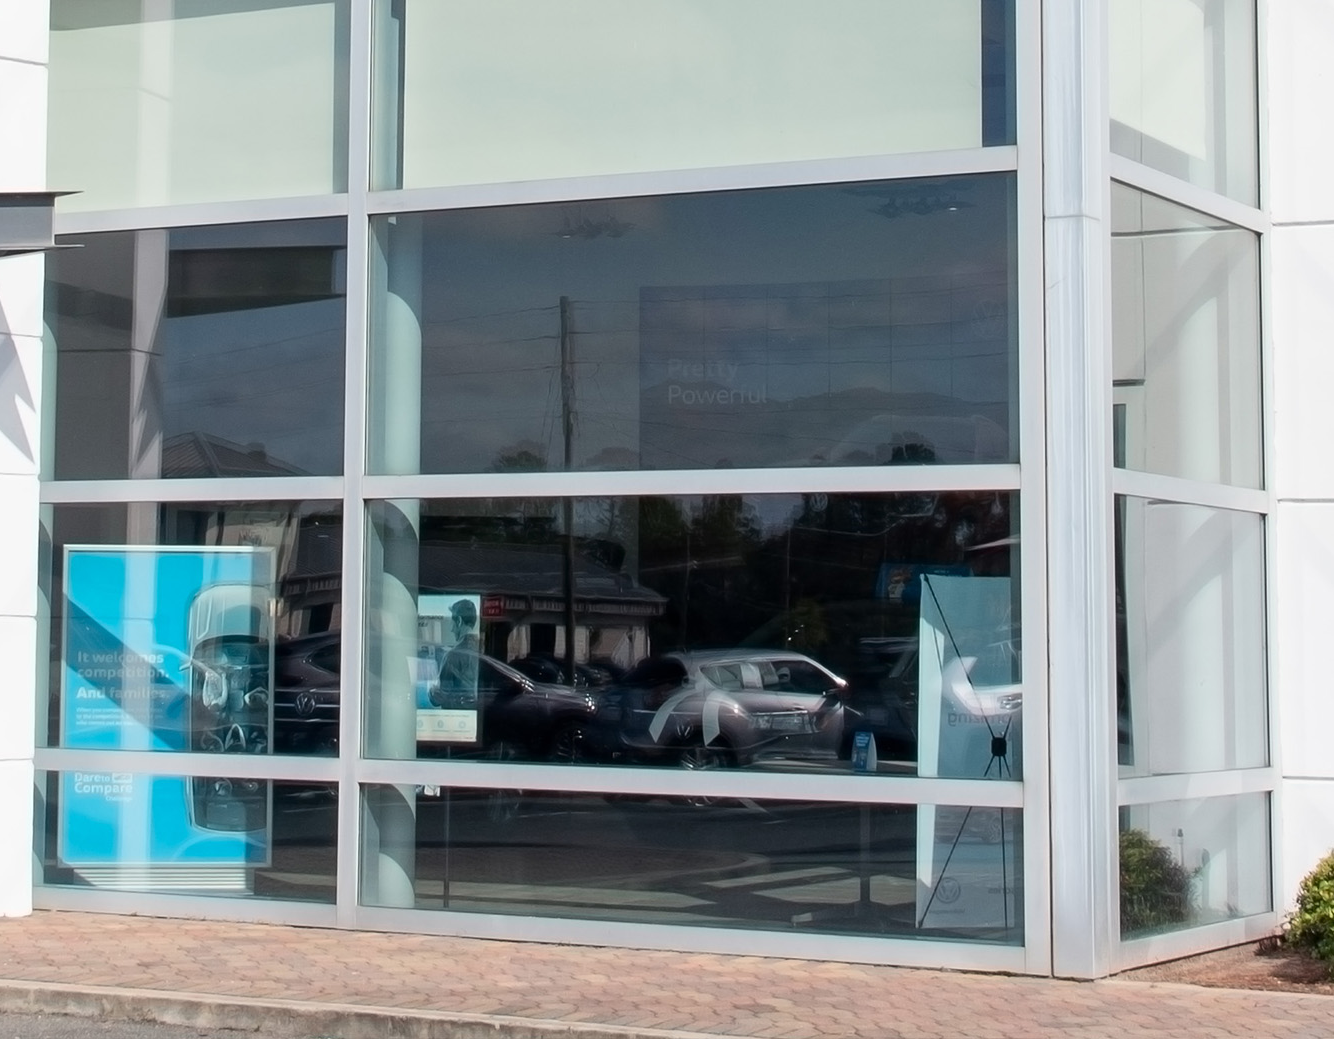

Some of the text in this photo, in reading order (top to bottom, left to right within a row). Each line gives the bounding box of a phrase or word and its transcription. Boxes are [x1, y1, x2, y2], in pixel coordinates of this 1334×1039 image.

[668, 384, 767, 405] Powerful
[77, 650, 165, 664] It welcomes
[77, 666, 169, 680] competition.
[76, 687, 106, 699] And
[74, 772, 101, 783] Dare
[74, 782, 133, 795] Compare
